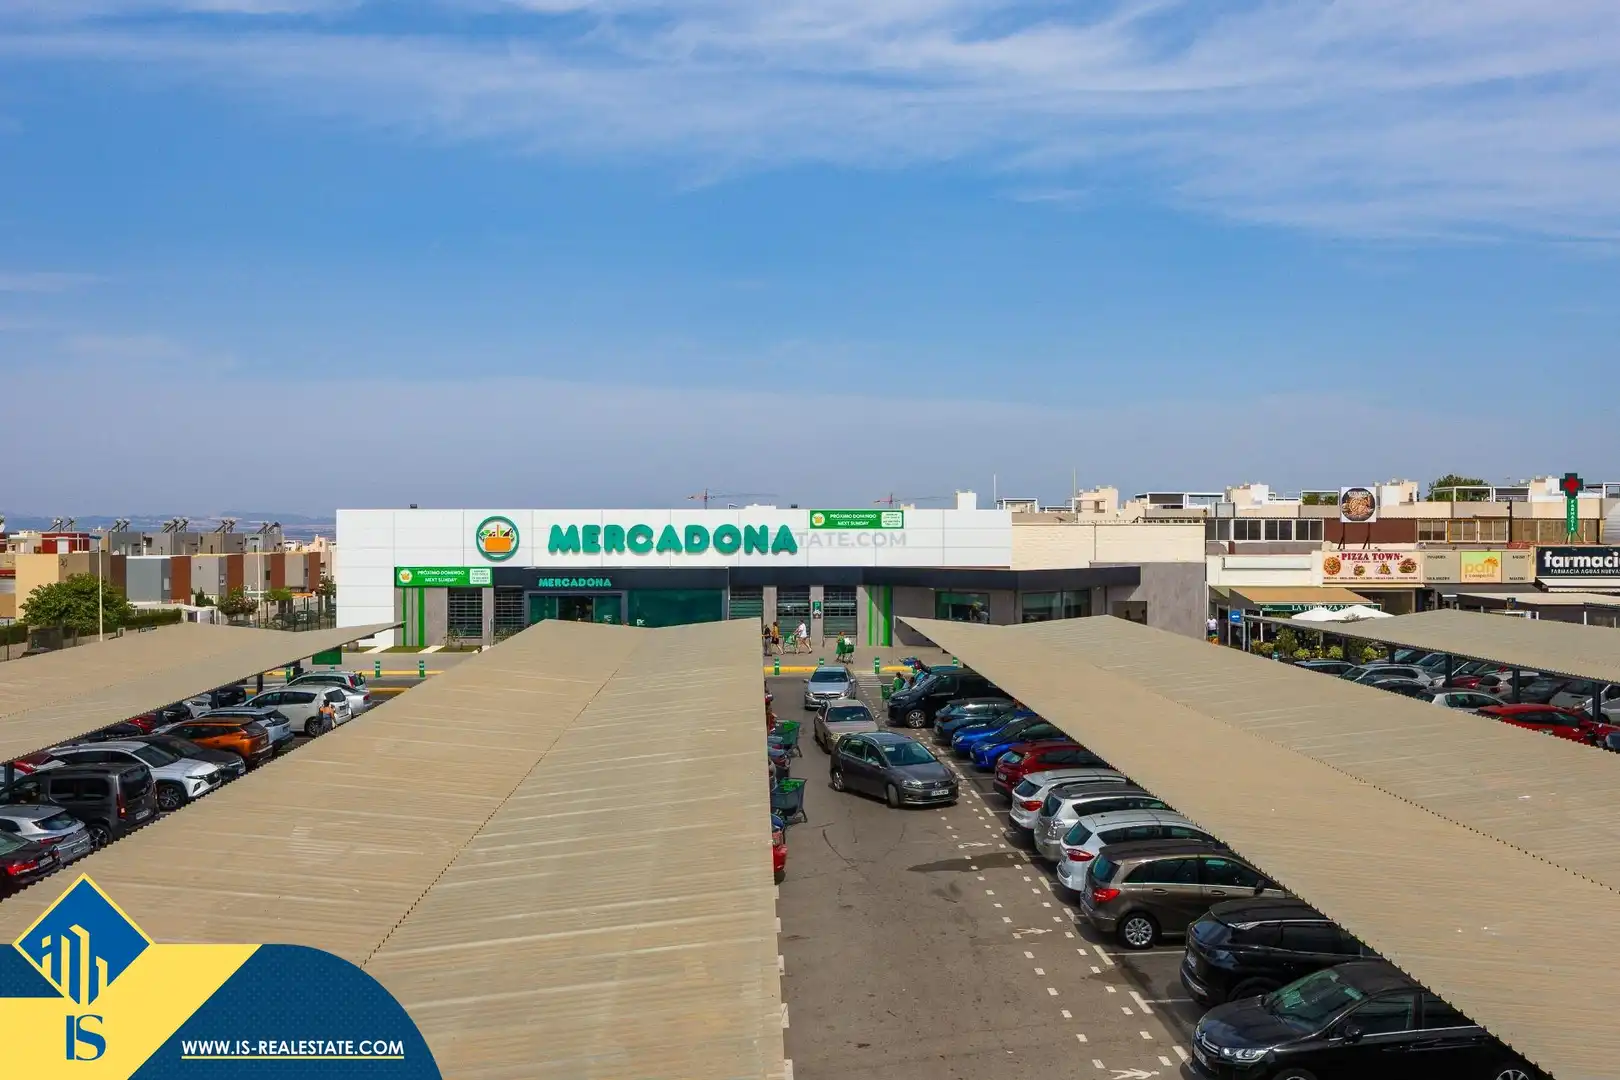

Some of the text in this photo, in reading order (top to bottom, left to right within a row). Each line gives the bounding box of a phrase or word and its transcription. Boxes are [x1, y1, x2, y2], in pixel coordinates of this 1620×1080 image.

[548, 524, 798, 555] MERCADONA
[1341, 553, 1401, 561] PIZZA TOWN
[1544, 550, 1620, 568] farmaci
[538, 577, 612, 588] MERCADONA
